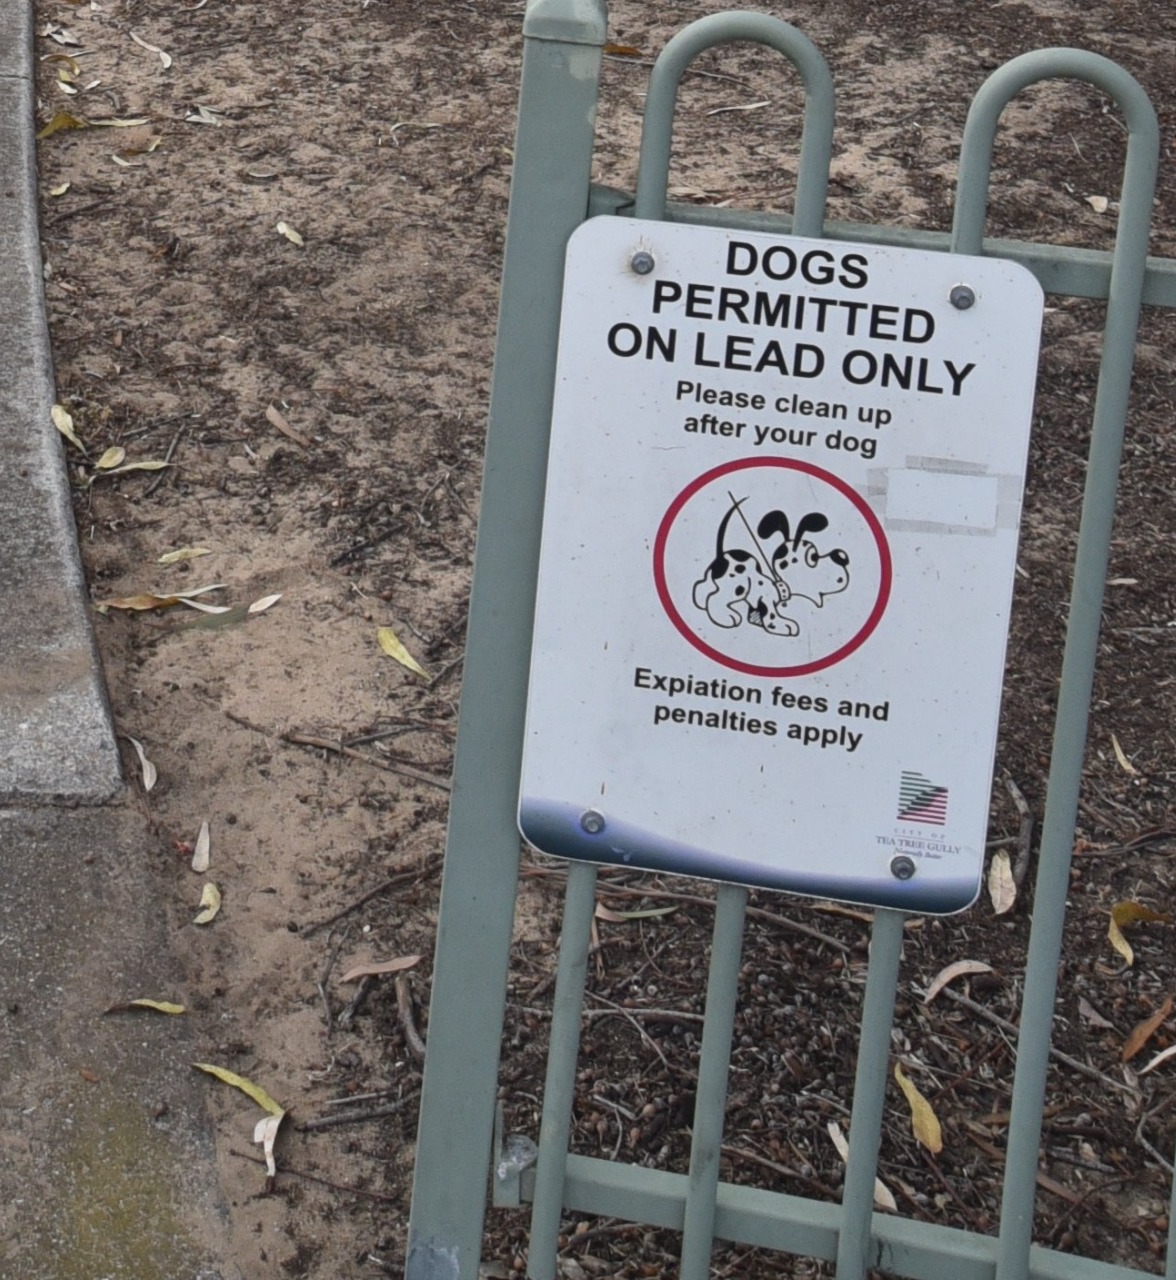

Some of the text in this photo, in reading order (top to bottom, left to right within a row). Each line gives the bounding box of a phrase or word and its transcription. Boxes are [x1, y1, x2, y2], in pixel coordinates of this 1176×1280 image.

[726, 241, 868, 289] DOGS
[652, 280, 935, 344] PERMITTED
[607, 323, 976, 396] ON LEAD ONLY
[676, 380, 892, 430] Please clean up
[684, 414, 877, 460] after your dog
[635, 668, 890, 722] Expiation fees and
[654, 705, 863, 753] penalties apply
[875, 835, 961, 854] TEA TREE GULLY
